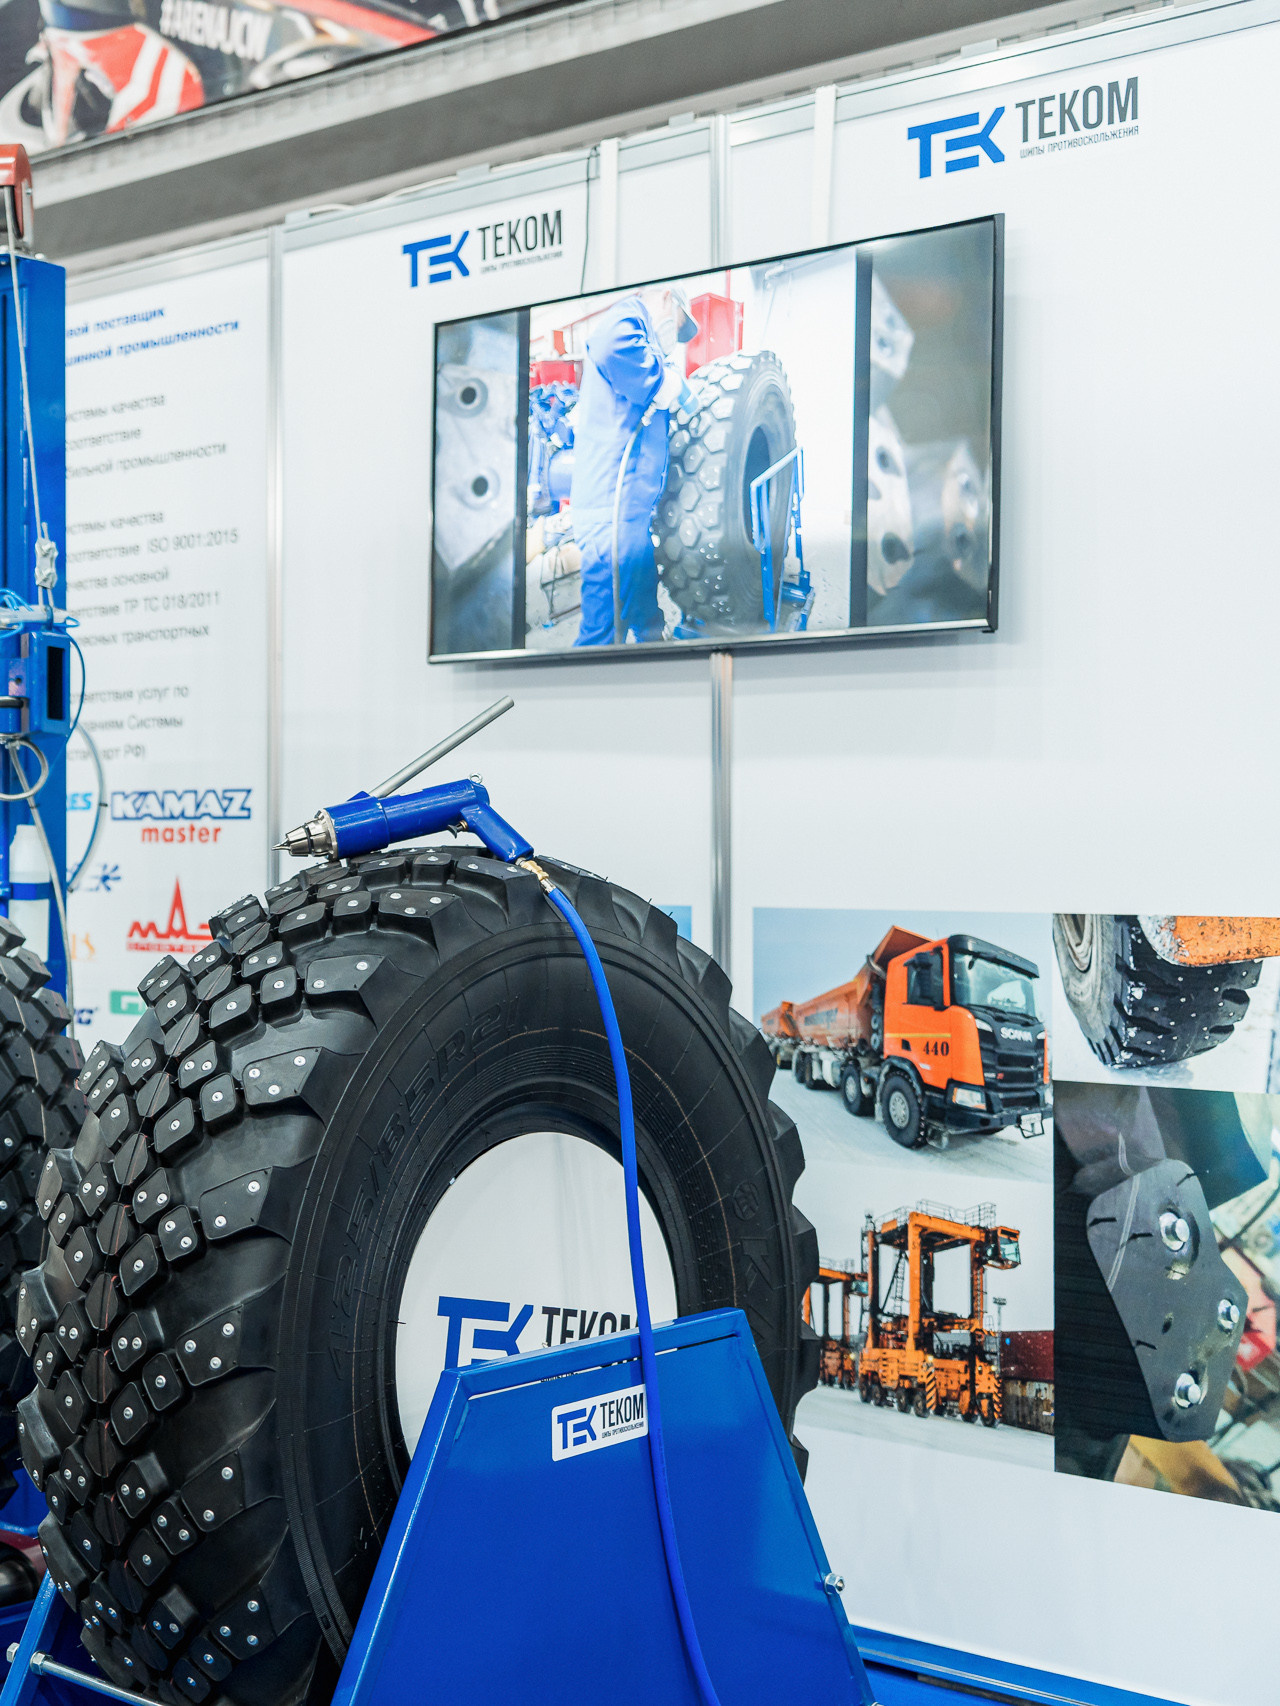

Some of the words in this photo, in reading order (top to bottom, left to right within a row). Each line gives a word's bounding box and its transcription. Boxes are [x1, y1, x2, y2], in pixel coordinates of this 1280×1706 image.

[94, 307, 165, 332] поставщик
[118, 321, 238, 355] промышленности
[148, 536, 168, 552] ISO
[173, 528, 239, 550] 9001:2015
[163, 591, 219, 611] 018/2011
[111, 788, 252, 820] KAMAZ
[141, 823, 222, 843] master
[923, 1041, 949, 1056] 440
